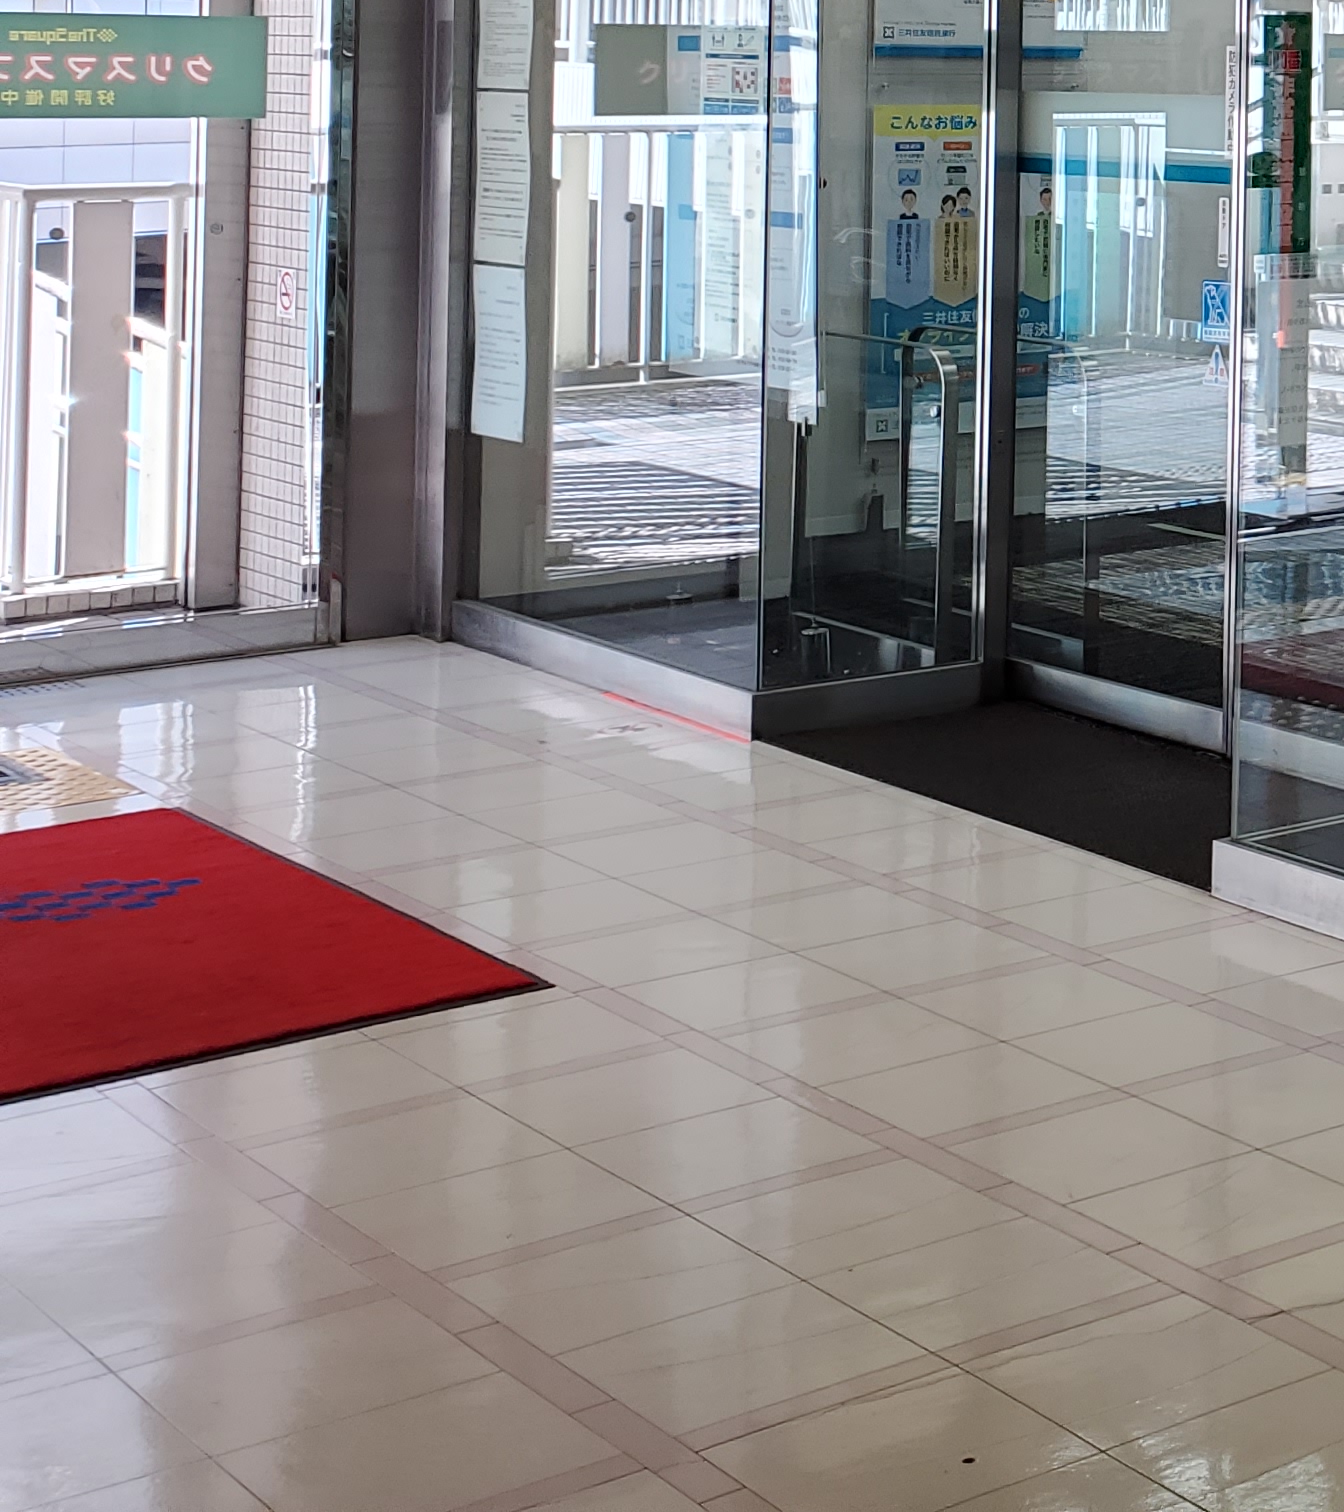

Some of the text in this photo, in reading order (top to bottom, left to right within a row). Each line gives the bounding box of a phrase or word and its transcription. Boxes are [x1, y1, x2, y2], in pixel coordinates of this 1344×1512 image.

[890, 115, 979, 131] こんなお悩み
[922, 310, 976, 325] 三井住友
